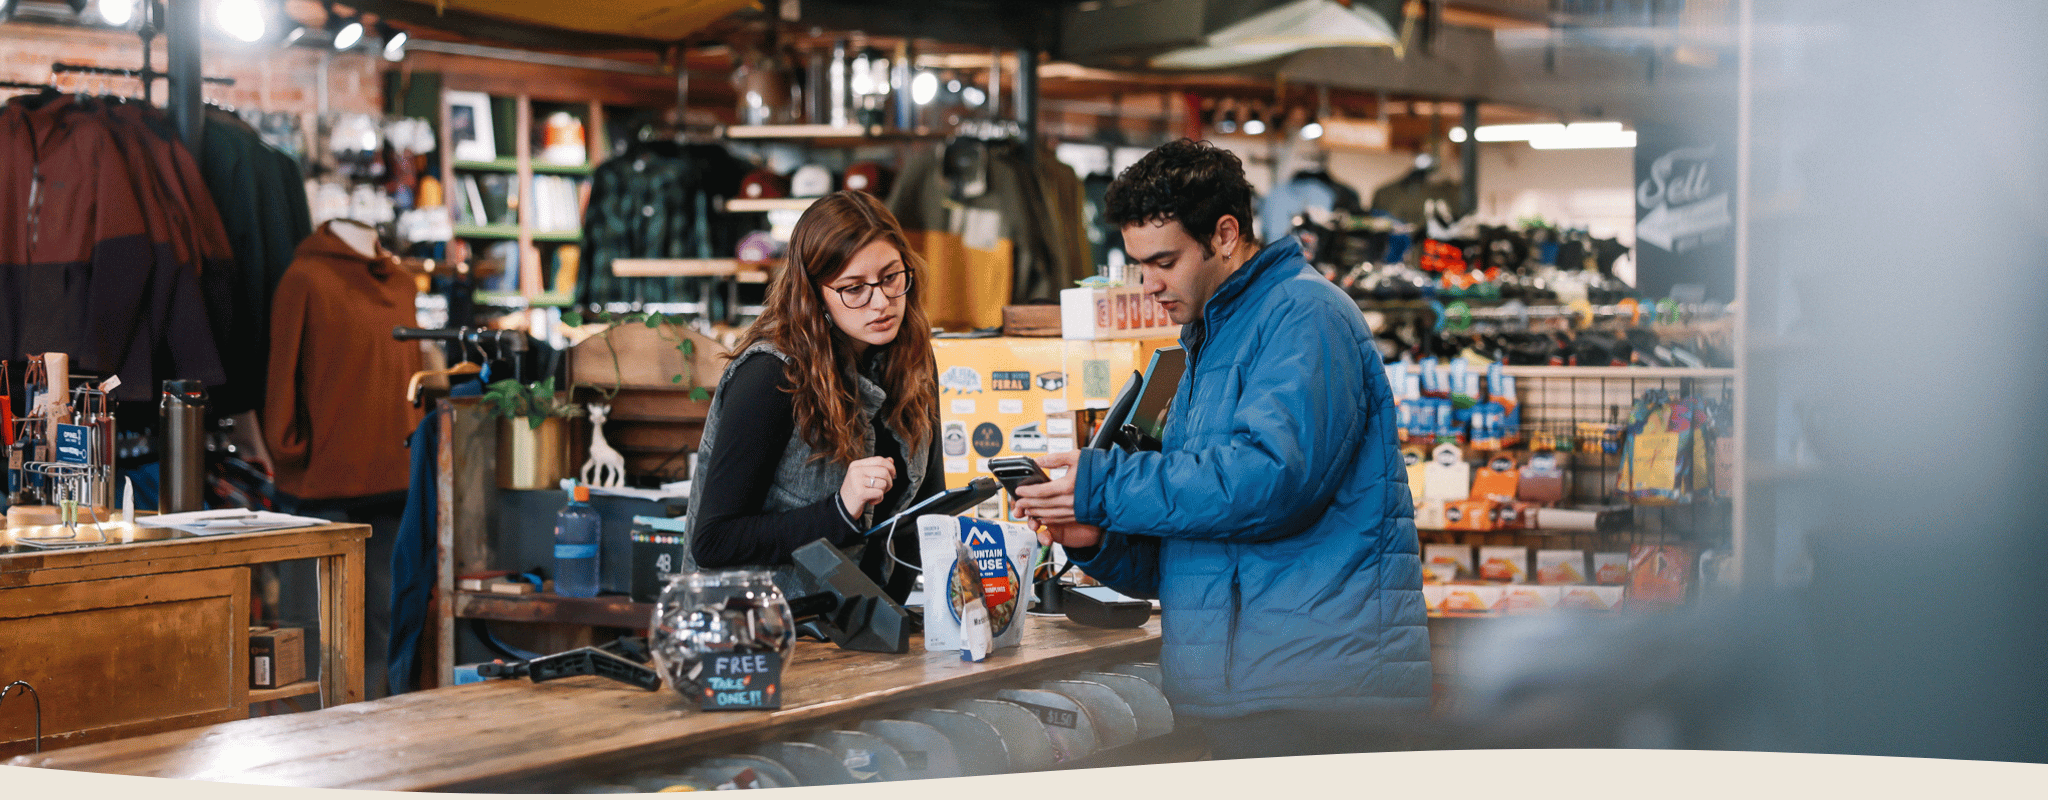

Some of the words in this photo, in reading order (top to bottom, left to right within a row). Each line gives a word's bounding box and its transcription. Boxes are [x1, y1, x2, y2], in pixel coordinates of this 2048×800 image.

[1637, 147, 1715, 210] Sell
[992, 380, 1024, 390] FERAL
[974, 440, 1000, 448] FERAL
[973, 549, 1003, 559] UNTAIN
[655, 553, 671, 573] 48
[978, 559, 1004, 571] USE
[715, 655, 769, 675] FREE
[707, 677, 745, 690] TAKE
[716, 690, 762, 706] ONE!!
